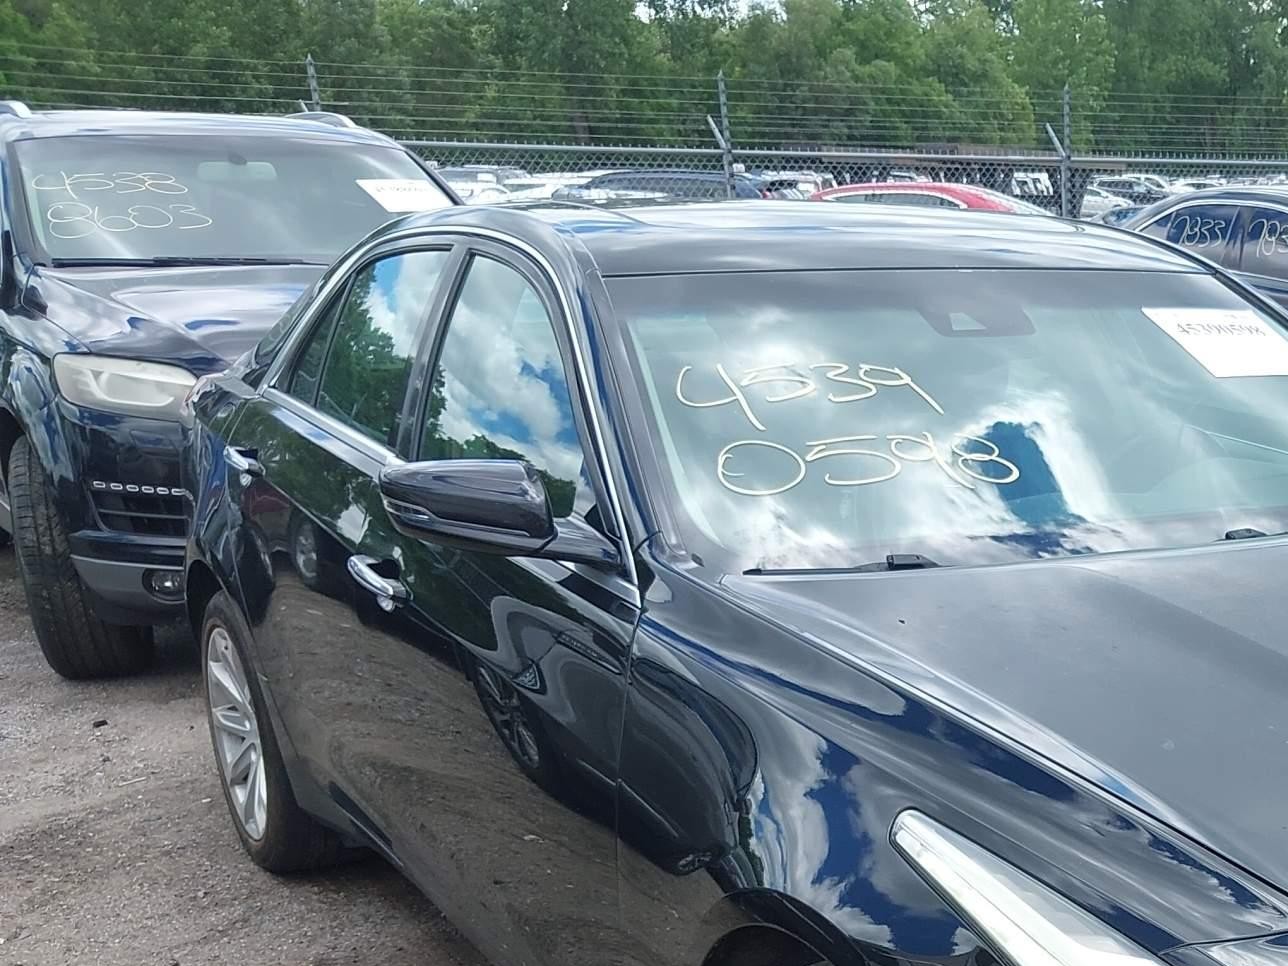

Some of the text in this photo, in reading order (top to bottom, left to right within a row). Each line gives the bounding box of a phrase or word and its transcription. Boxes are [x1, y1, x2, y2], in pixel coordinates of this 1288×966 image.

[31, 170, 189, 200] 4538
[47, 201, 213, 239] 8603
[675, 363, 945, 432] 4539
[717, 431, 1021, 496] 0598
